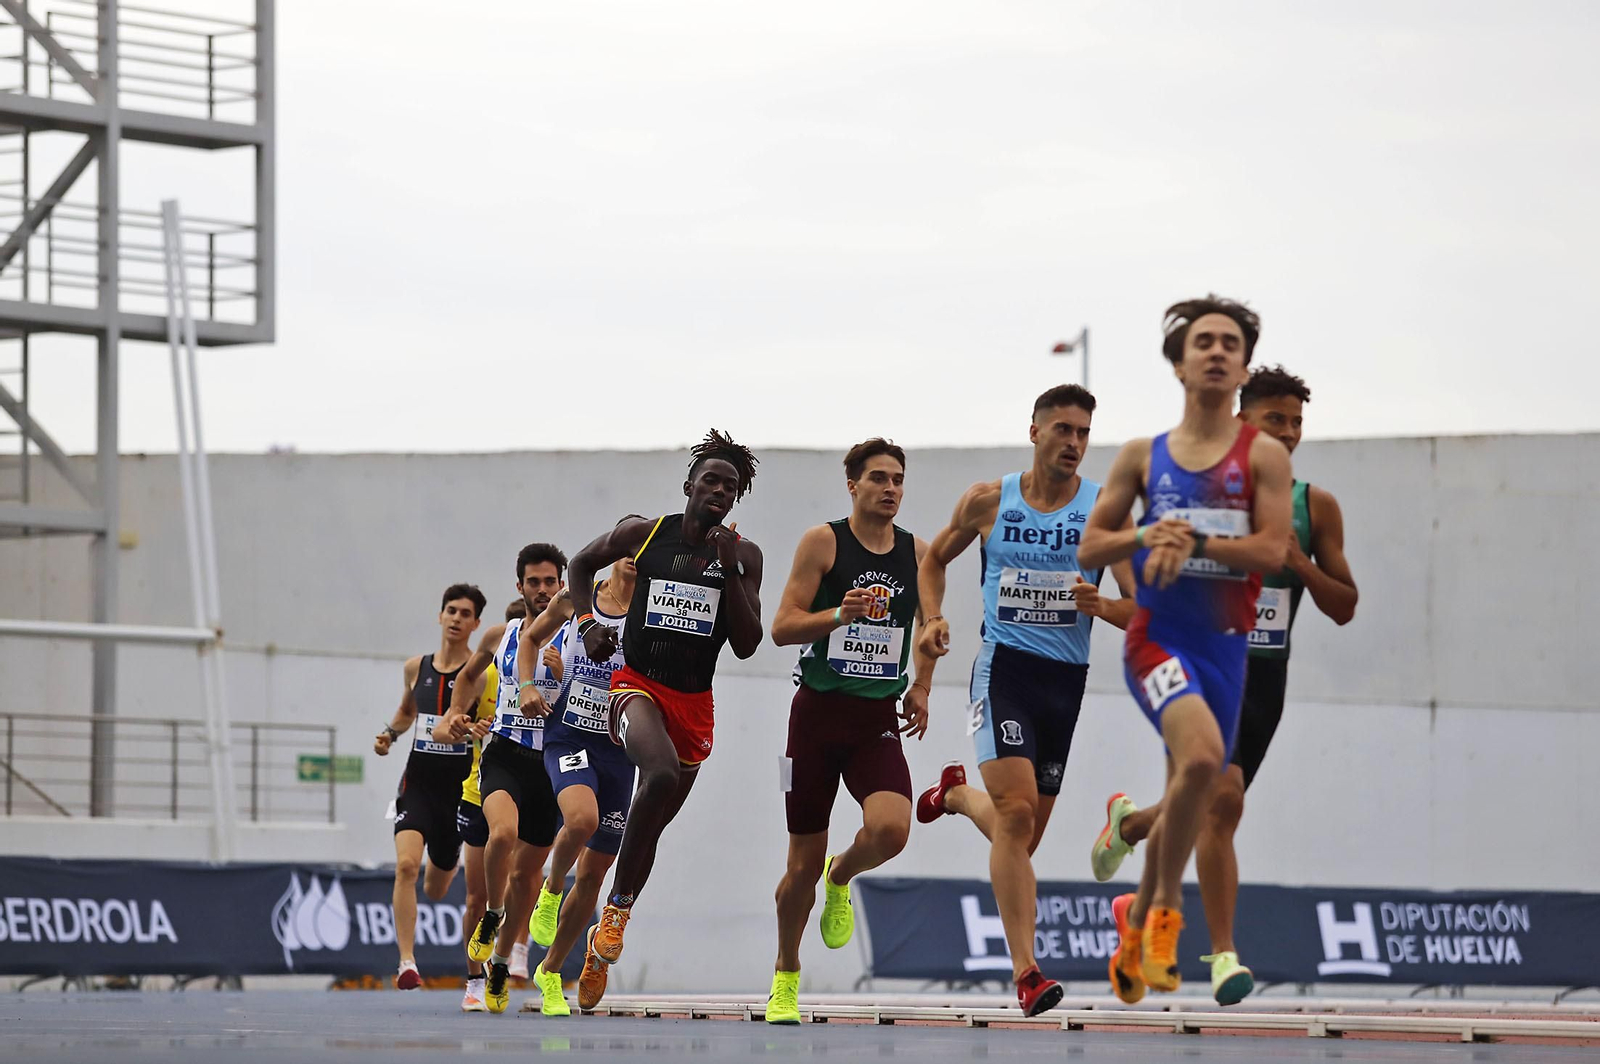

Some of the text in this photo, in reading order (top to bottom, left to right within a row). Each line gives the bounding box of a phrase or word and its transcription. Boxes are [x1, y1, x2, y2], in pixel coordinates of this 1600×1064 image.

[1002, 523, 1081, 551] nerja
[1013, 551, 1071, 564] ATLETISMO
[1000, 586, 1076, 601] MARTINEZ
[652, 595, 711, 614] VIAFARA
[1033, 600, 1046, 609] 39
[676, 608, 688, 617] 38
[843, 640, 889, 655] BADIA
[861, 653, 874, 662] 36
[1150, 666, 1183, 698] 12
[591, 711, 602, 720] 40
[0, 897, 178, 943] ERDROLA
[1380, 899, 1531, 933] DIPUTACIÓN
[1385, 934, 1523, 966] DE HUELVA
